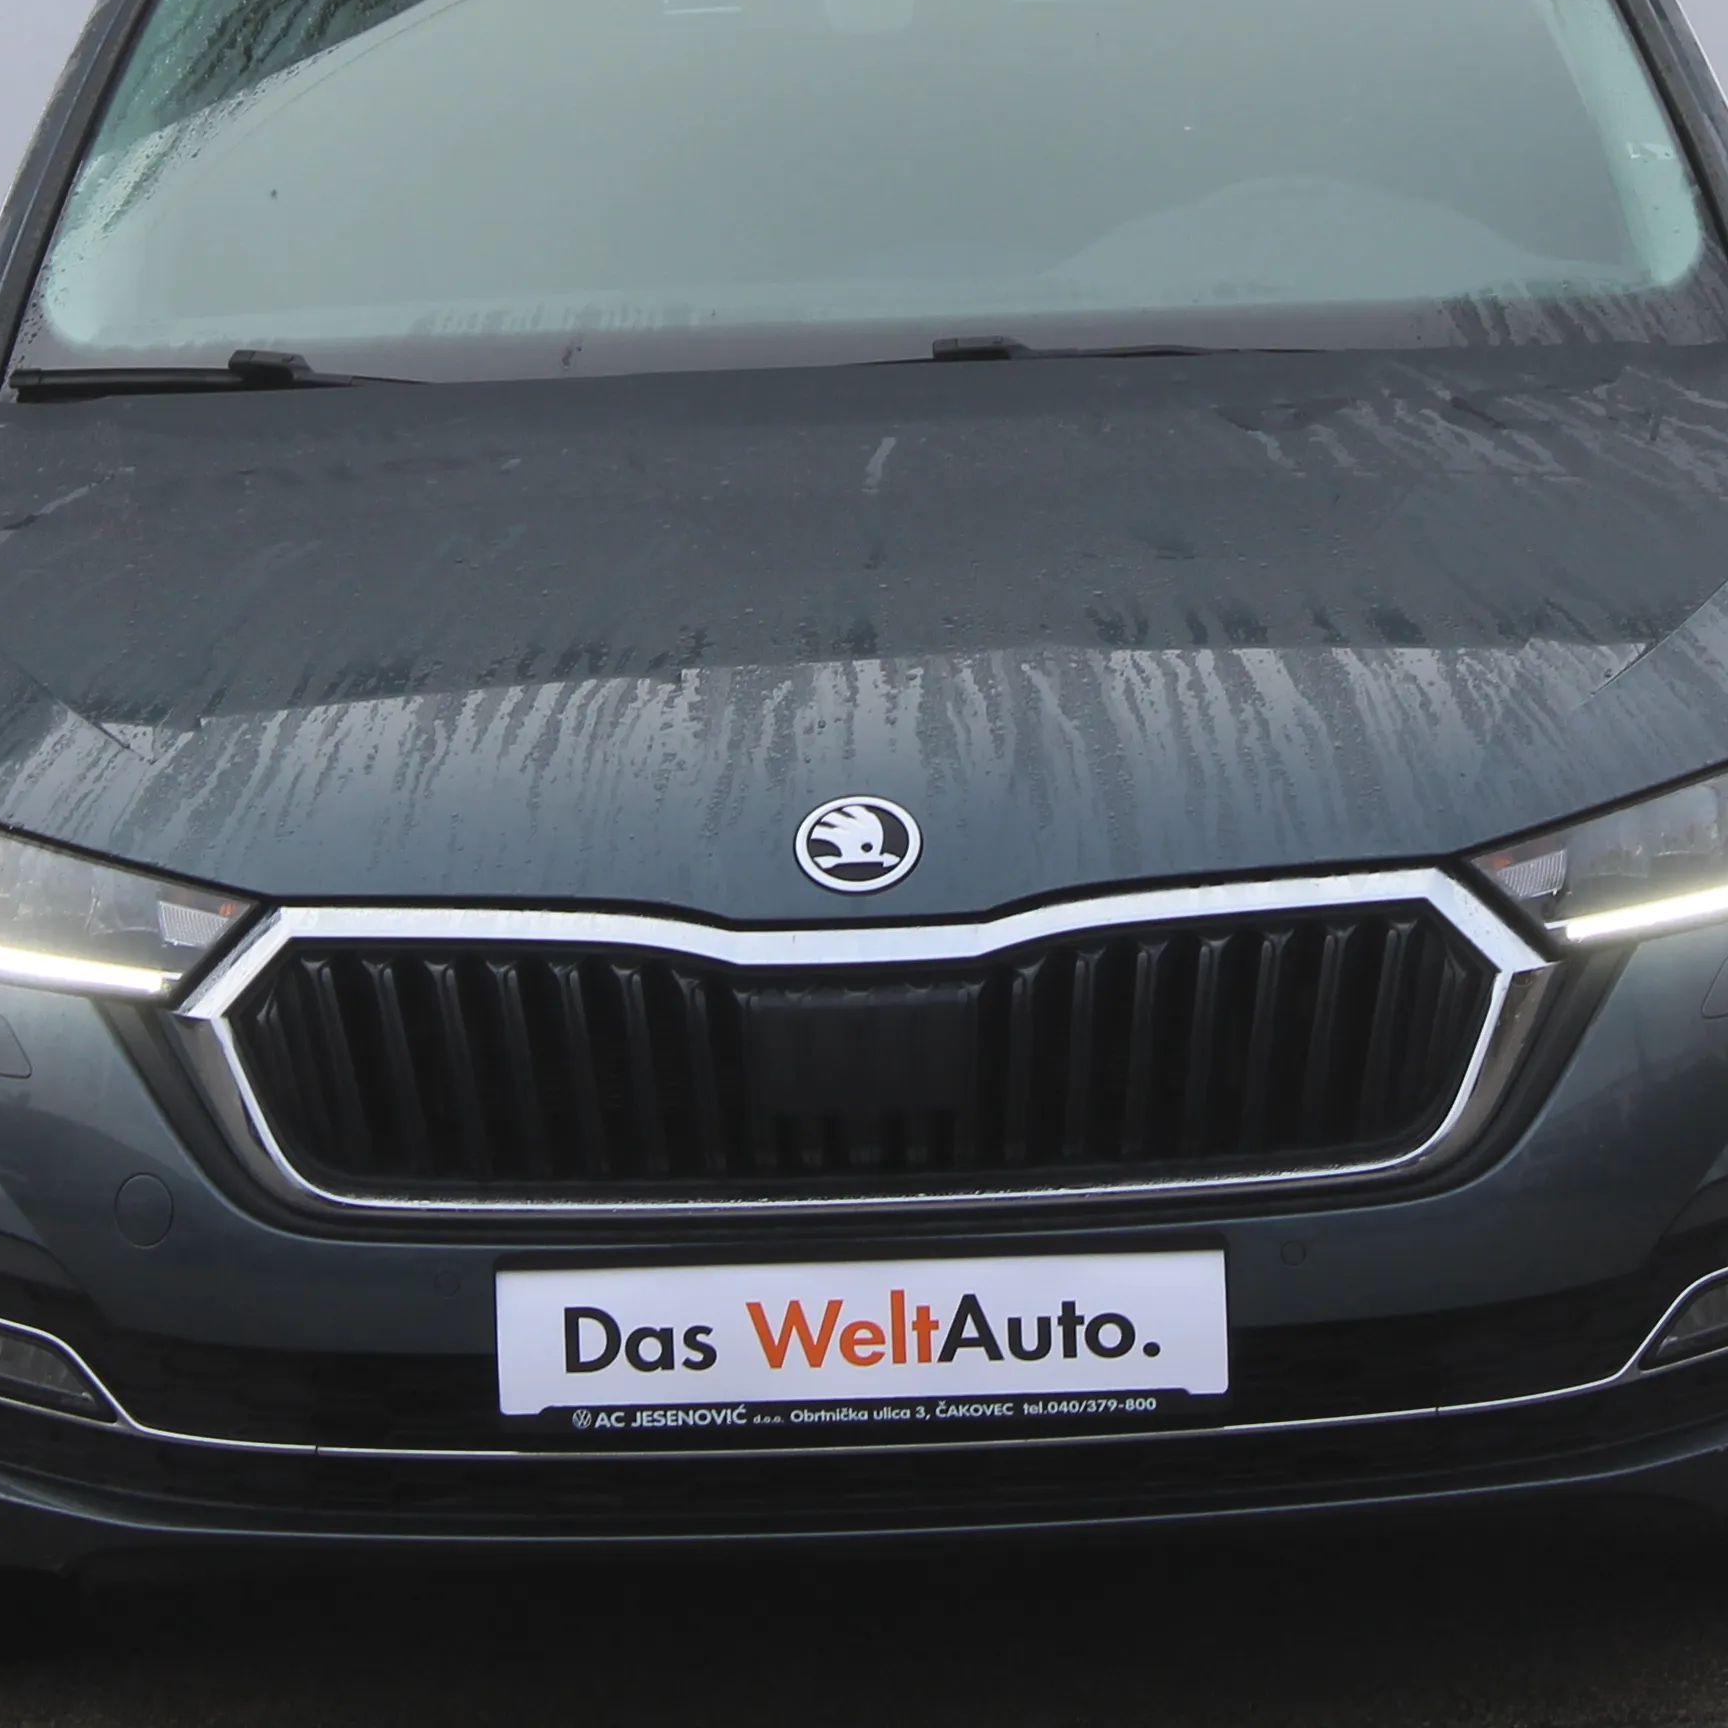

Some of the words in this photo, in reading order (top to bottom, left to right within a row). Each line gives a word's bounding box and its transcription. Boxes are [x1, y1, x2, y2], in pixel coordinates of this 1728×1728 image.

[563, 1306, 718, 1374] Das
[744, 1289, 1161, 1372] WeltAuto.
[594, 1410, 626, 1429] AC
[630, 1403, 747, 1428] JESENOVIĆ
[753, 1414, 785, 1424] d.o.o.
[790, 1406, 869, 1423] Obrtnička
[873, 1405, 911, 1420] ulica
[915, 1405, 931, 1421] 3,
[935, 1400, 1014, 1418] ČAKOVEC
[1022, 1397, 1157, 1415] tel.040/379-800
